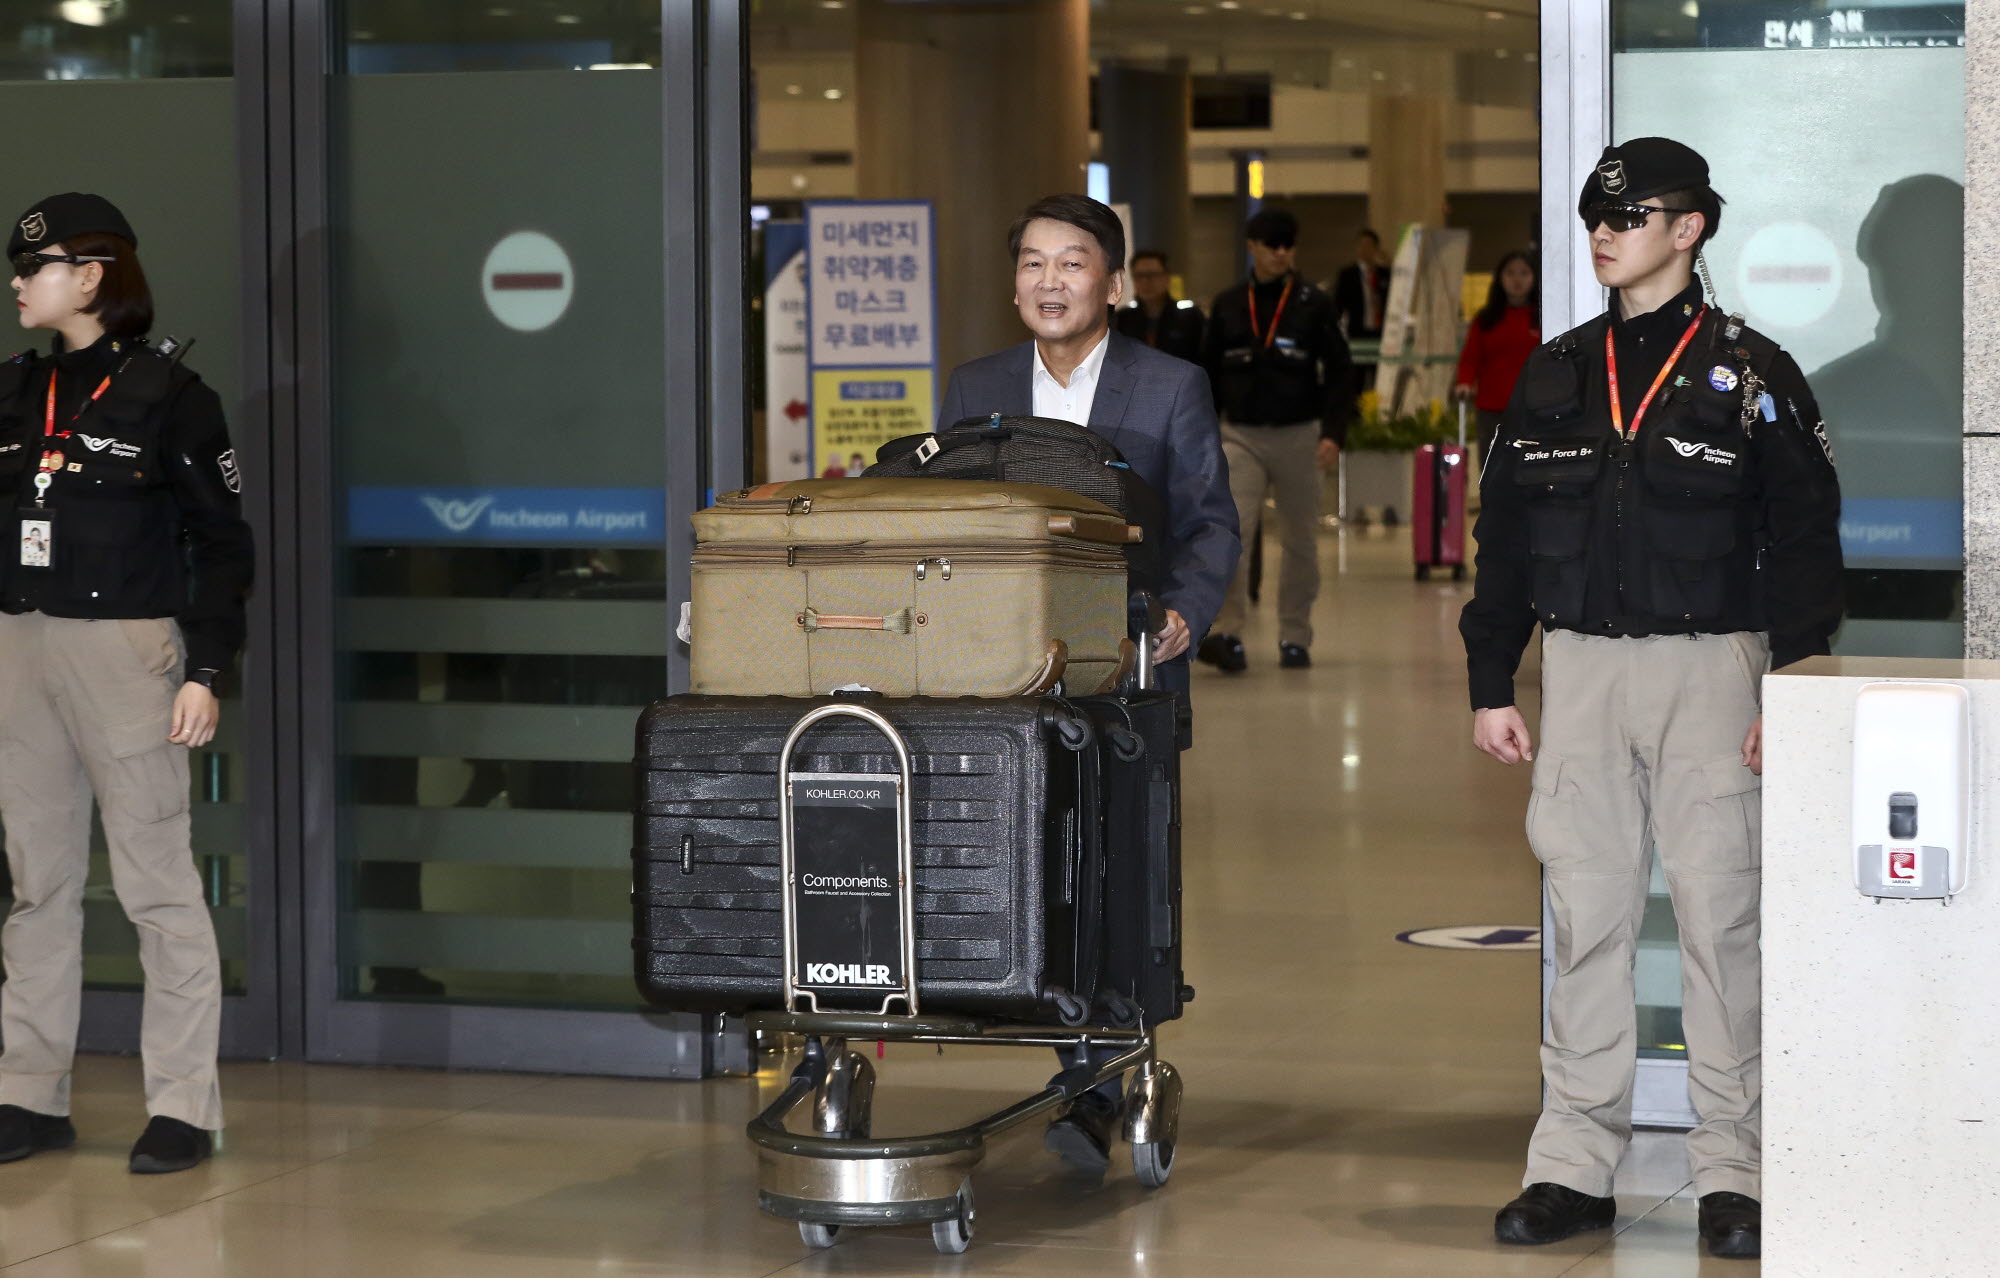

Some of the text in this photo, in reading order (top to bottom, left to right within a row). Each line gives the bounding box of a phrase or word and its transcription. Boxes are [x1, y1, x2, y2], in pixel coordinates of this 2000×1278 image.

[822, 220, 918, 248] 미세먼지
[823, 254, 920, 282] 취약계층
[835, 289, 907, 315] 마스크
[824, 323, 921, 350] 무료배부
[109, 448, 137, 459] Airport
[1524, 447, 1593, 461] Strike Force B+
[1702, 454, 1732, 466] Airport
[1704, 446, 1737, 459] Incheon
[489, 508, 648, 532] Incheon Airport
[806, 788, 880, 800] KOHLER.CO.KR
[806, 962, 891, 985] KOHLER
